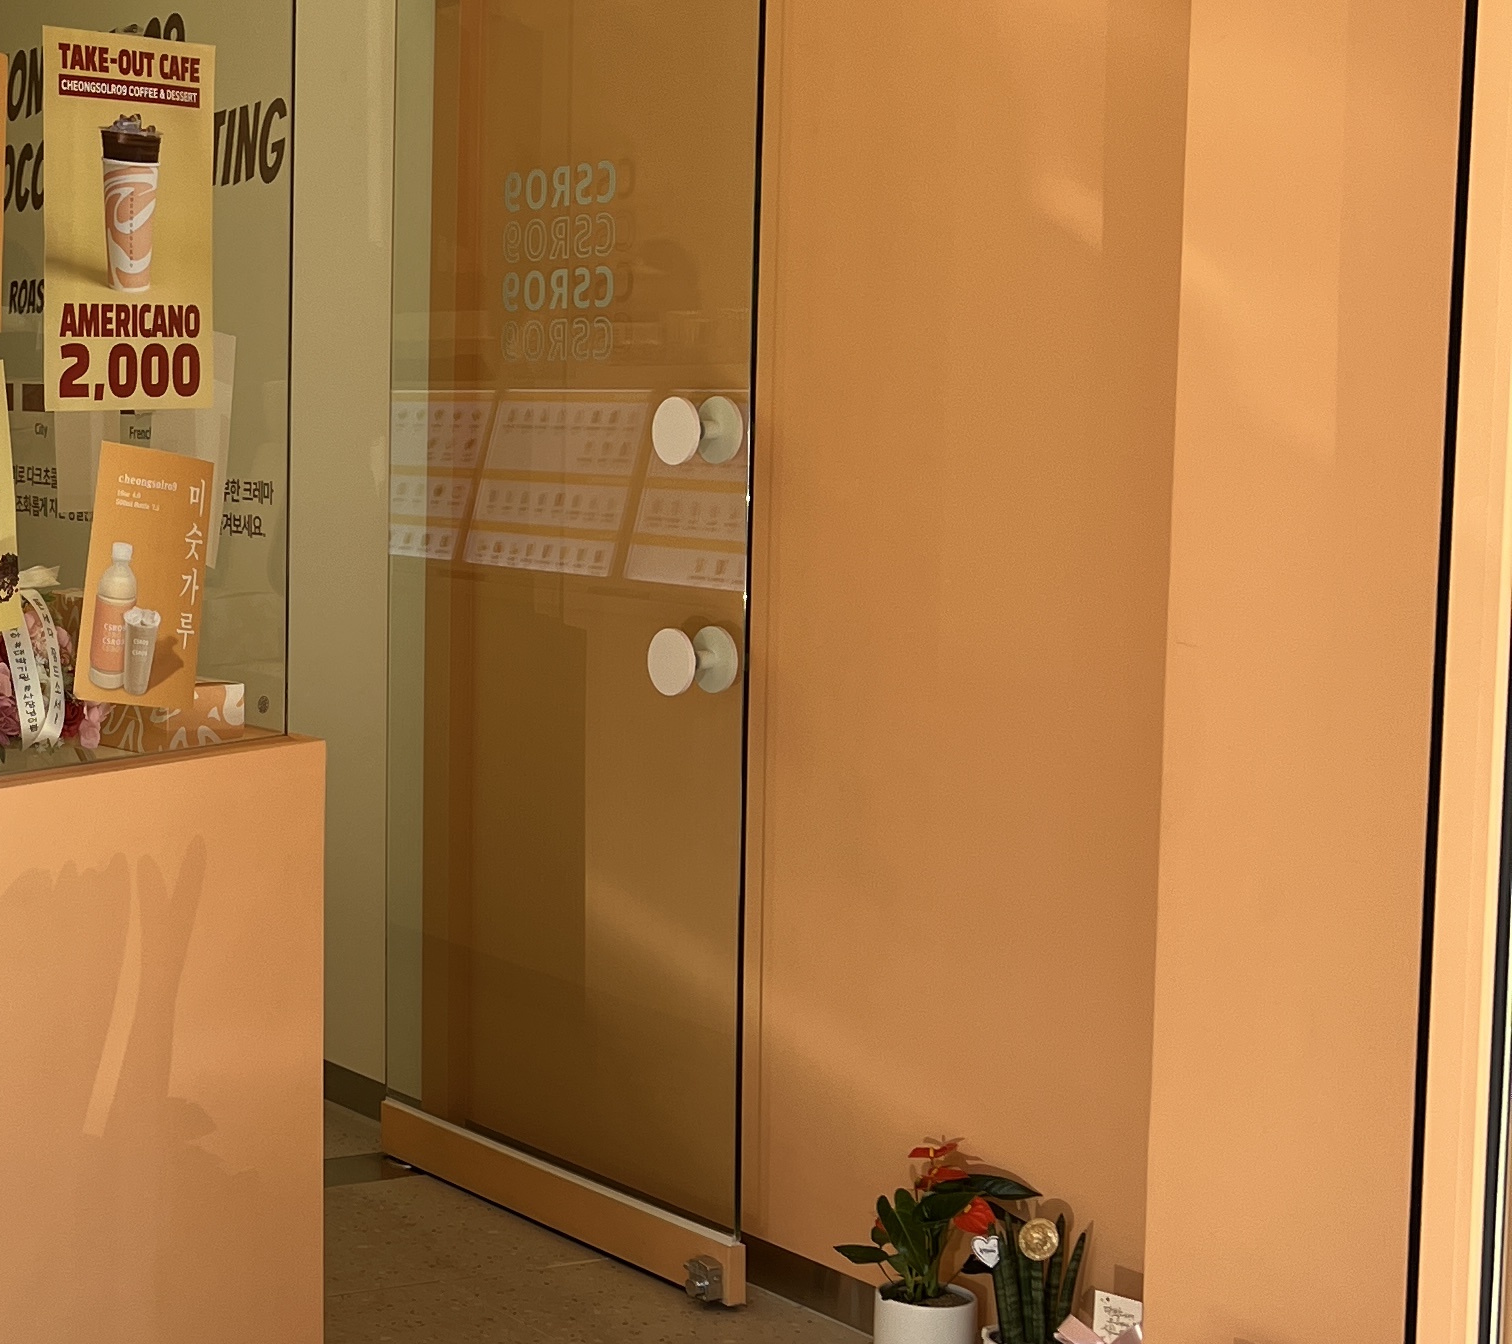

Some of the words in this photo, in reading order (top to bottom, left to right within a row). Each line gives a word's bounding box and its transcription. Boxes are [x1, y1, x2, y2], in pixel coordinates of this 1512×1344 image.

[58, 42, 155, 77] TAKE-OUT
[159, 54, 200, 83] CAFE
[129, 86, 158, 99] COFFEE
[159, 89, 165, 100] &
[166, 89, 198, 103] DESSERT
[8, 278, 45, 315] ROAS
[59, 302, 200, 338] AMERICANO
[58, 343, 201, 401] 2,000
[34, 422, 48, 439] City
[118, 473, 178, 492] cheongsolro9
[242, 480, 274, 505] 크레마
[219, 512, 266, 538] 겨보세요.
[176, 479, 206, 650] 미숫가루
